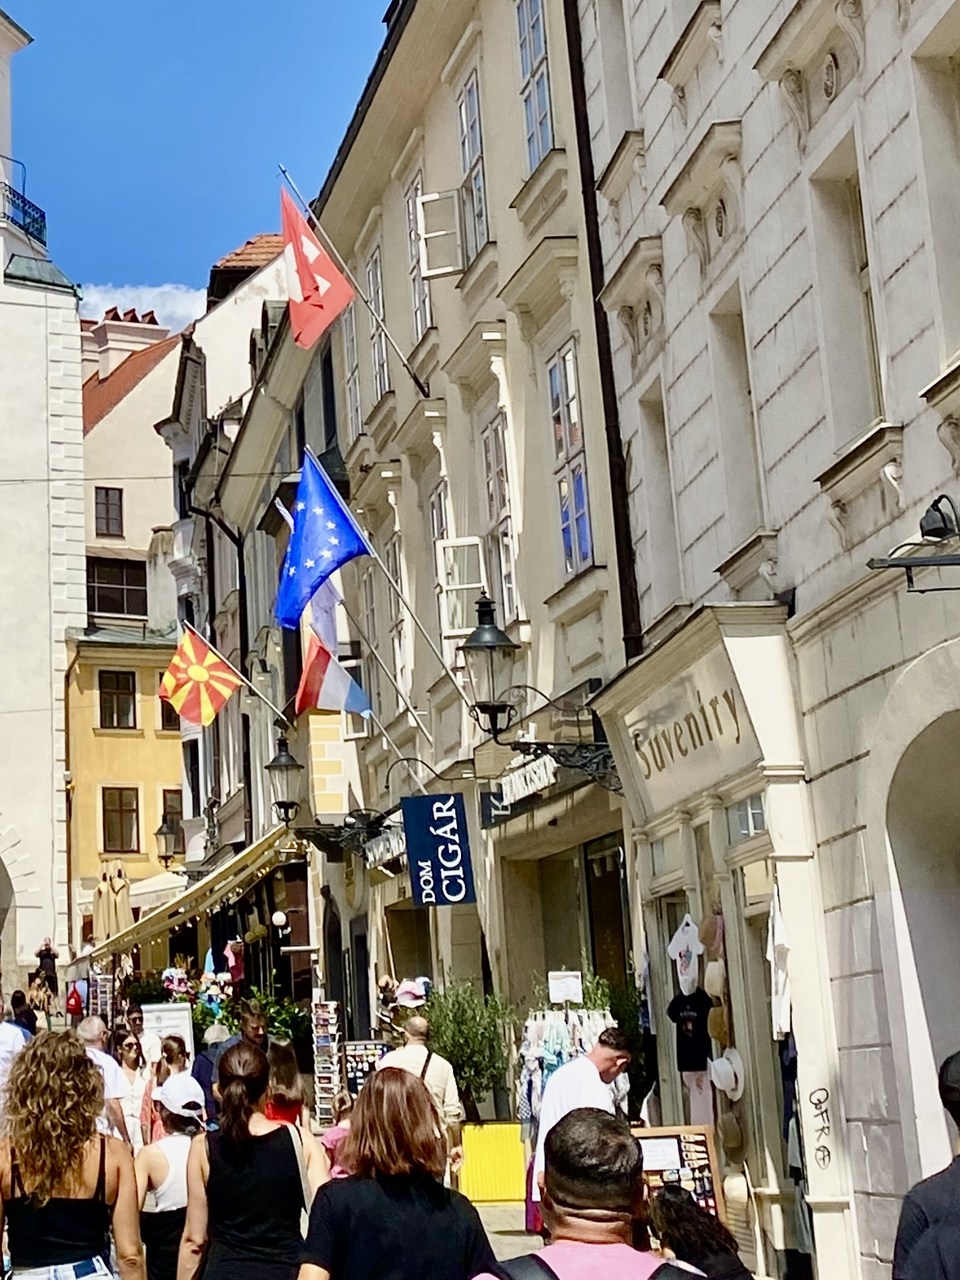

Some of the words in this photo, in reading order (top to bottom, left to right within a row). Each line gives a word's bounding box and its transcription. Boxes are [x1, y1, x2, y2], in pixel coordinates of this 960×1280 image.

[633, 687, 740, 780] Suveniry
[417, 859, 437, 904] DOM
[429, 795, 466, 903] CIGÁR
